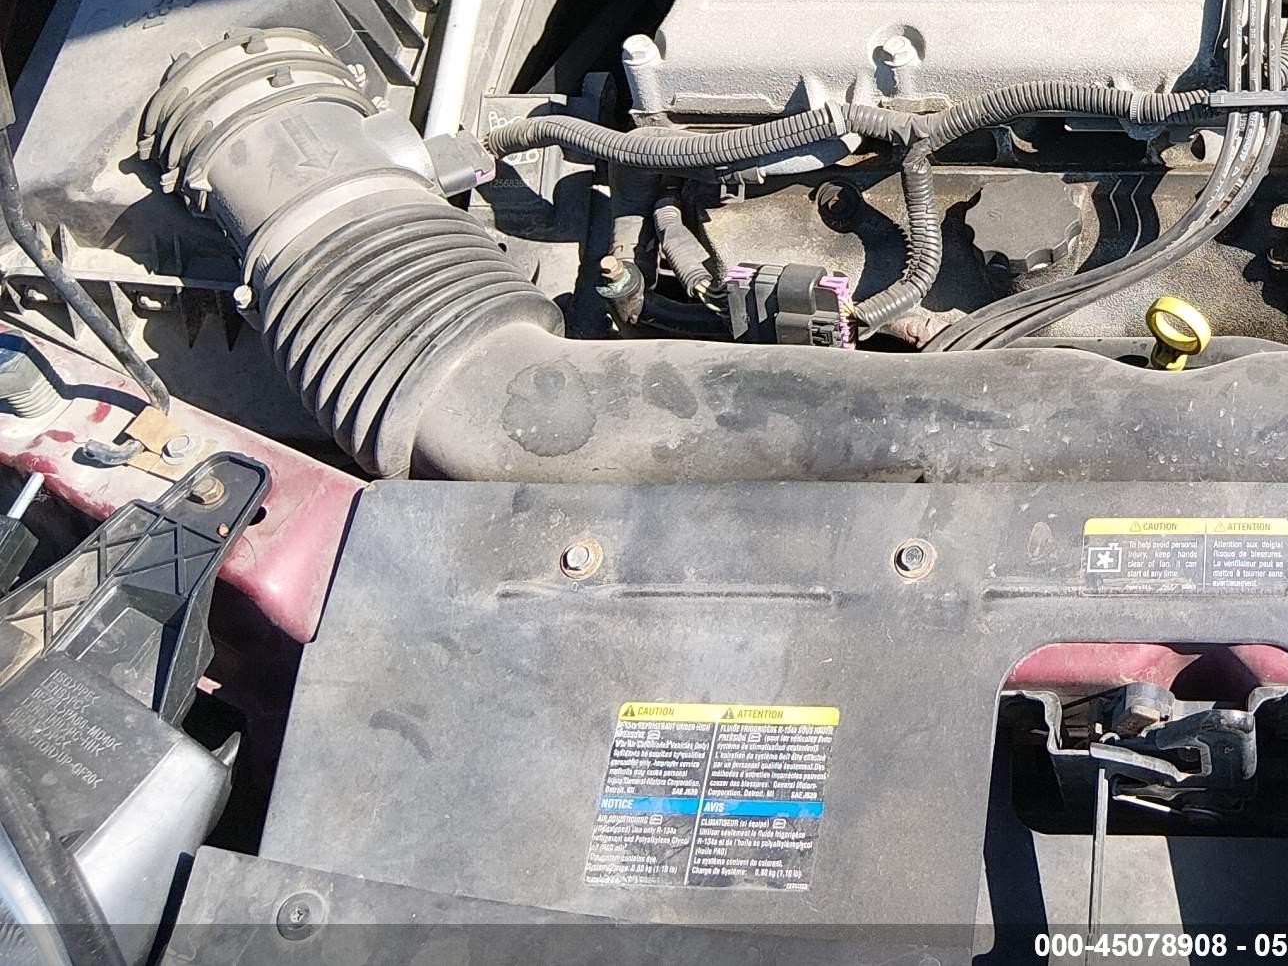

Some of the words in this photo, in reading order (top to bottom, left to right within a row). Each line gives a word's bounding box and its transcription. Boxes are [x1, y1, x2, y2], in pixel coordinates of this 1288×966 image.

[638, 707, 674, 716] CAUTION
[737, 710, 783, 718] ATTENTION
[601, 799, 634, 810] NOTICE
[704, 802, 724, 812] AVIS
